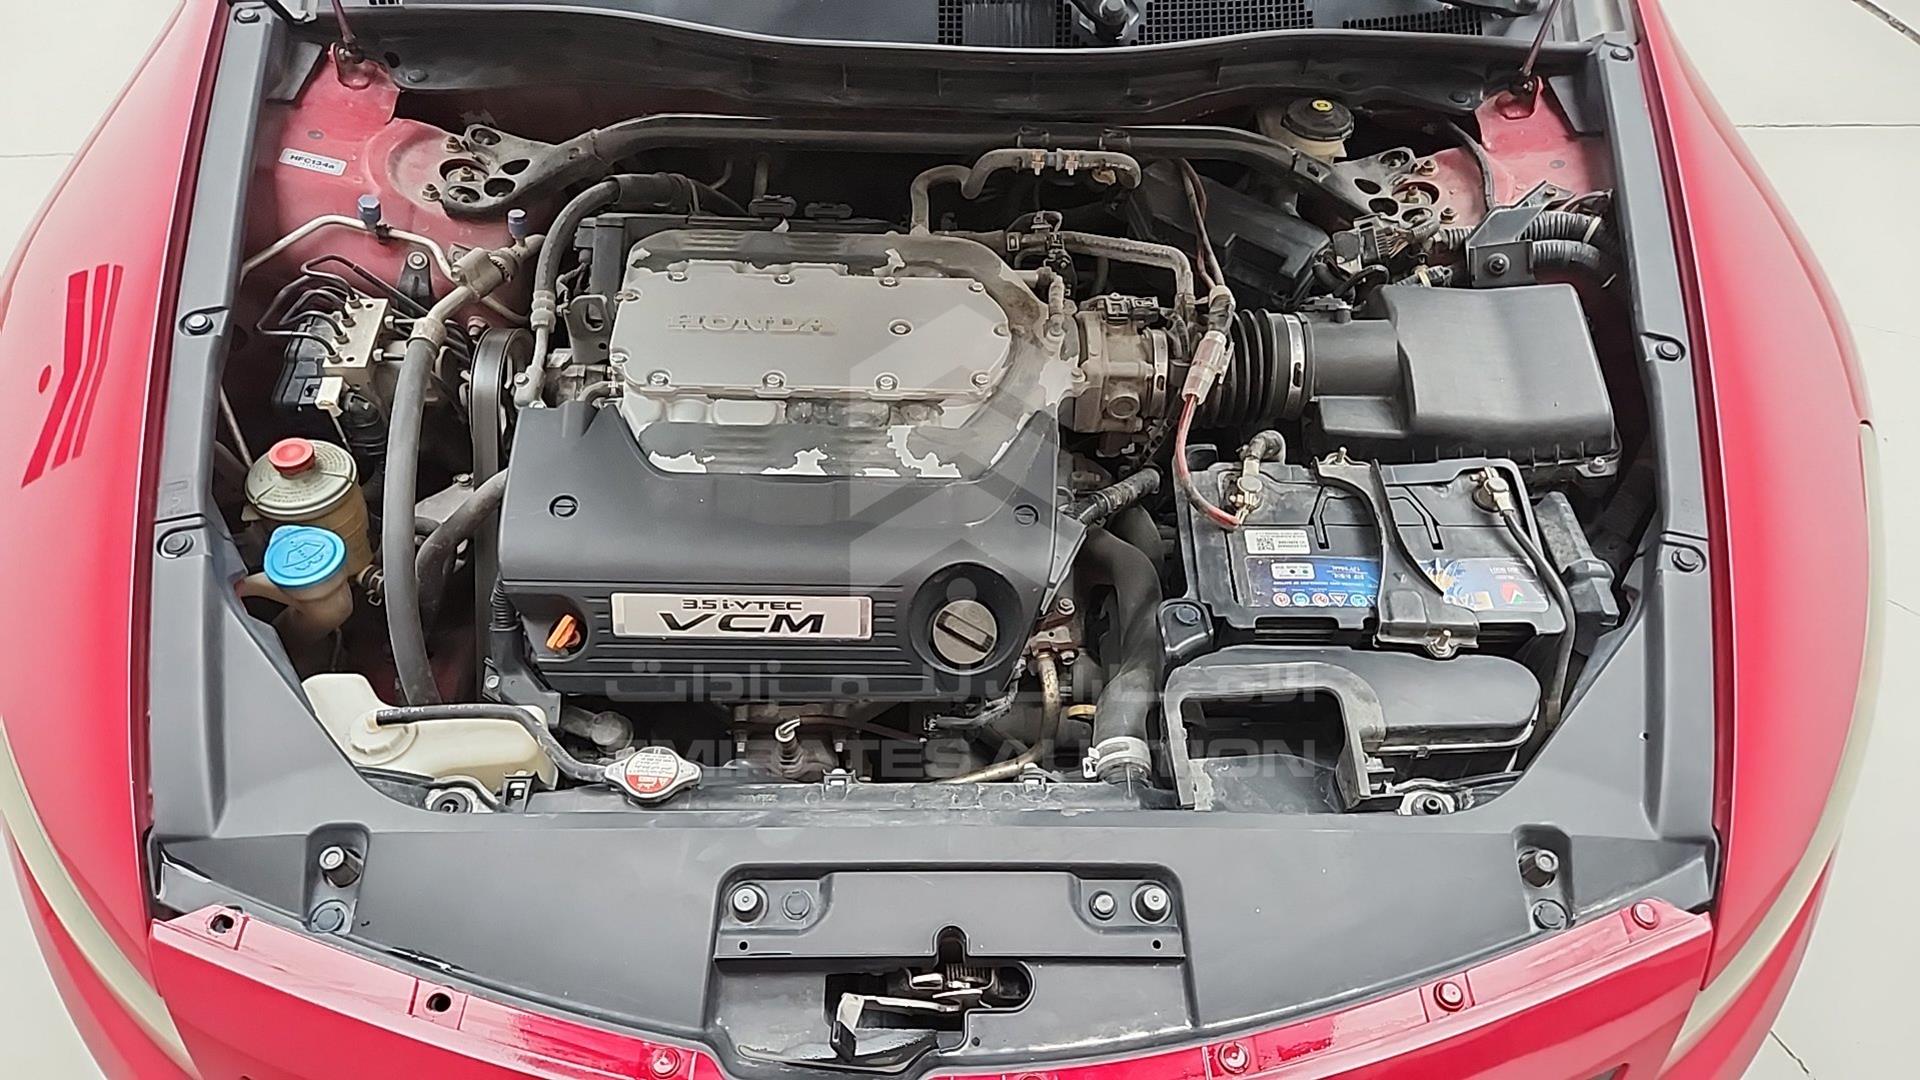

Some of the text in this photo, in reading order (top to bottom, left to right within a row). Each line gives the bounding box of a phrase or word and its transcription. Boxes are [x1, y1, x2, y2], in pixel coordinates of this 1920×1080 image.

[289, 154, 335, 169] HFC134a
[667, 314, 836, 335] HONDA
[658, 612, 827, 634] VCM
